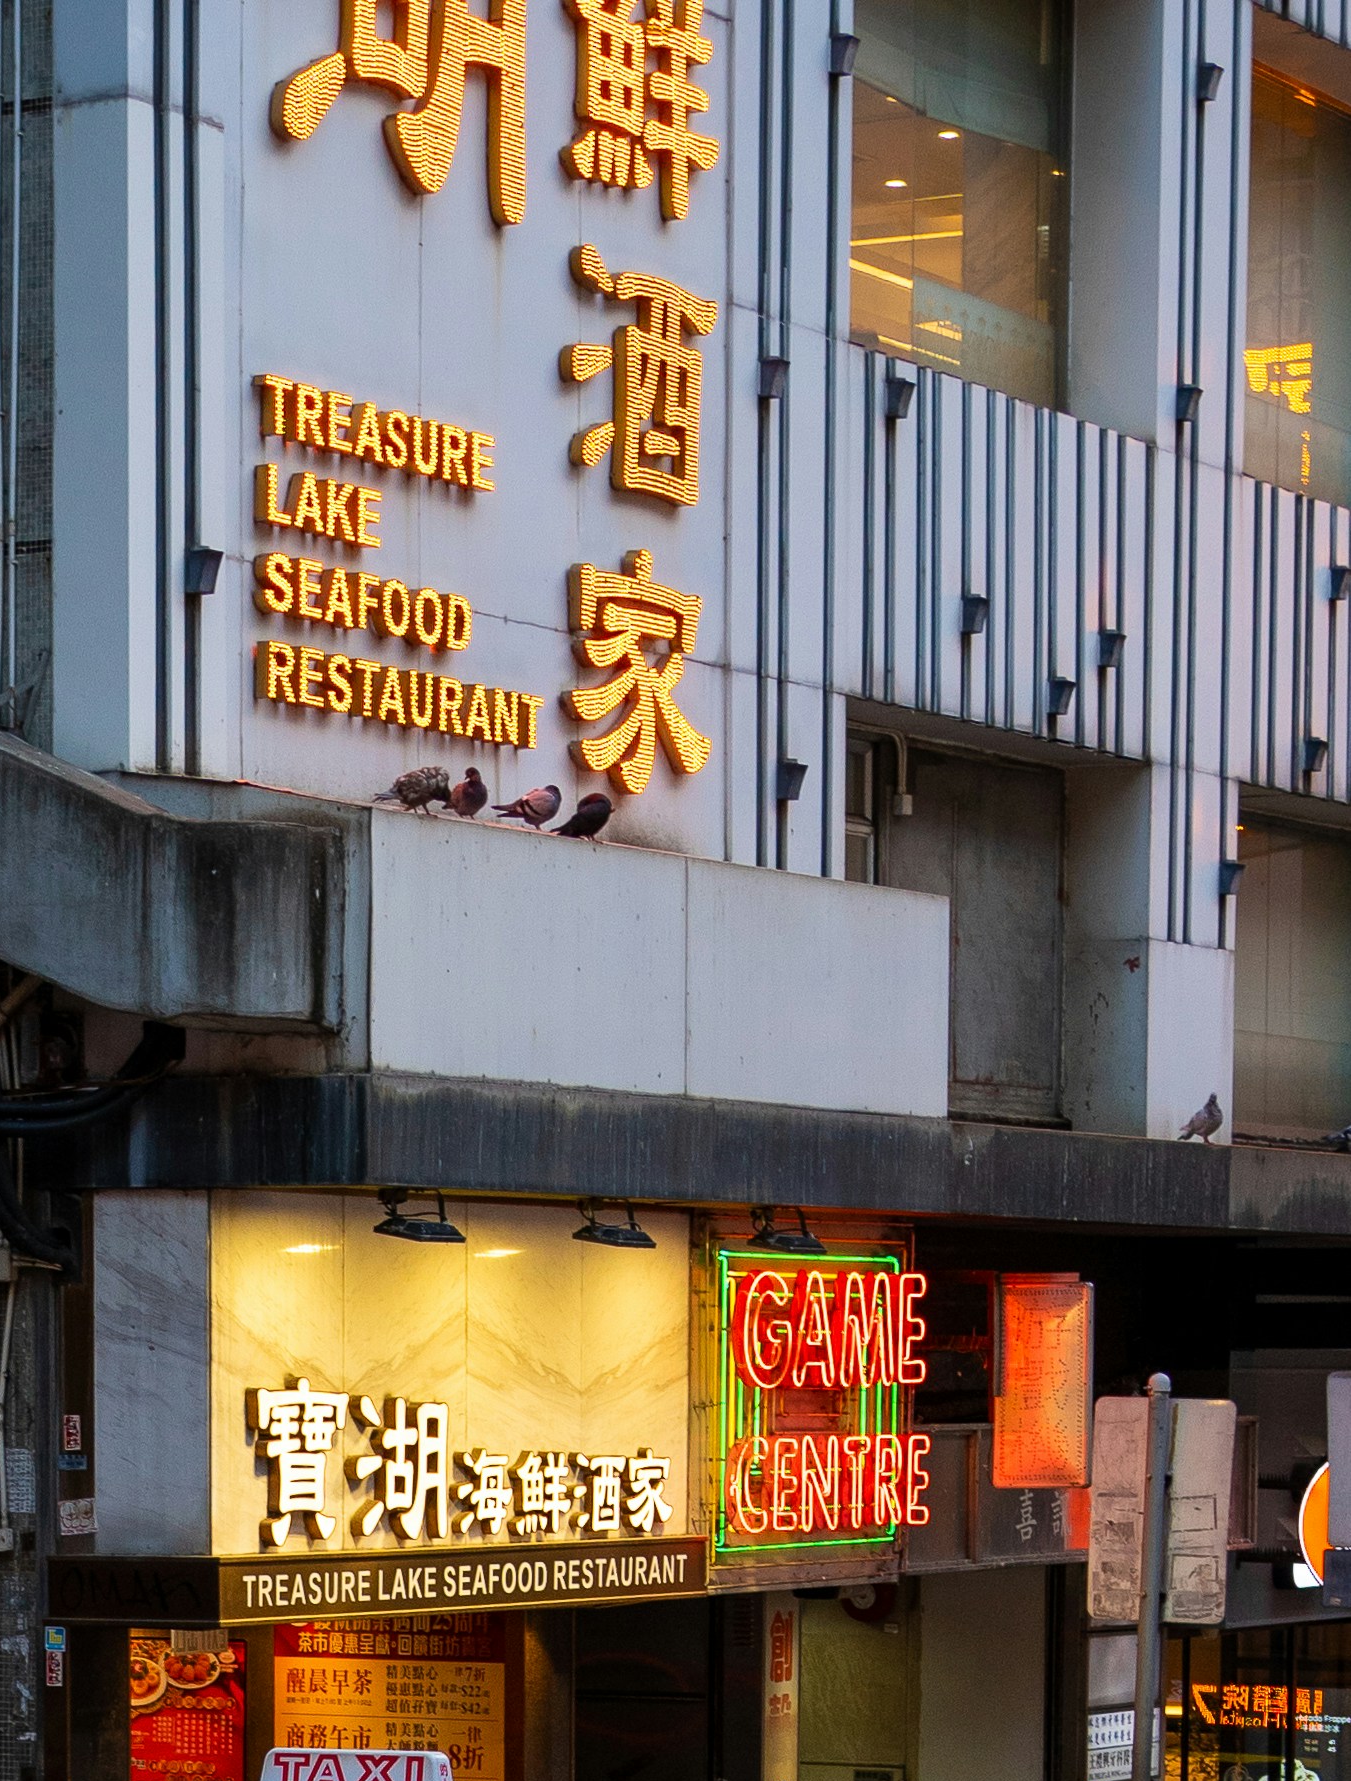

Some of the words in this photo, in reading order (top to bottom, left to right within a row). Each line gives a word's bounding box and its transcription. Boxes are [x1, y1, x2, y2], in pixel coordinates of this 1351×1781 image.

[254, 373, 496, 492] TREASURE
[255, 463, 383, 550] LAKE
[254, 552, 473, 653] SEAFOOD
[255, 639, 546, 750] RESTAURANT
[732, 1270, 927, 1389] GAME
[245, 1375, 673, 1547] 寶湖海鮮酒家
[725, 1434, 931, 1534] CENTRE
[243, 1569, 371, 1608] TREASURE
[378, 1567, 438, 1601] LAKE
[443, 1561, 549, 1598] SEAFOOD
[553, 1554, 688, 1590] RESTAURANT
[286, 1668, 373, 1695] 醒晨早茶
